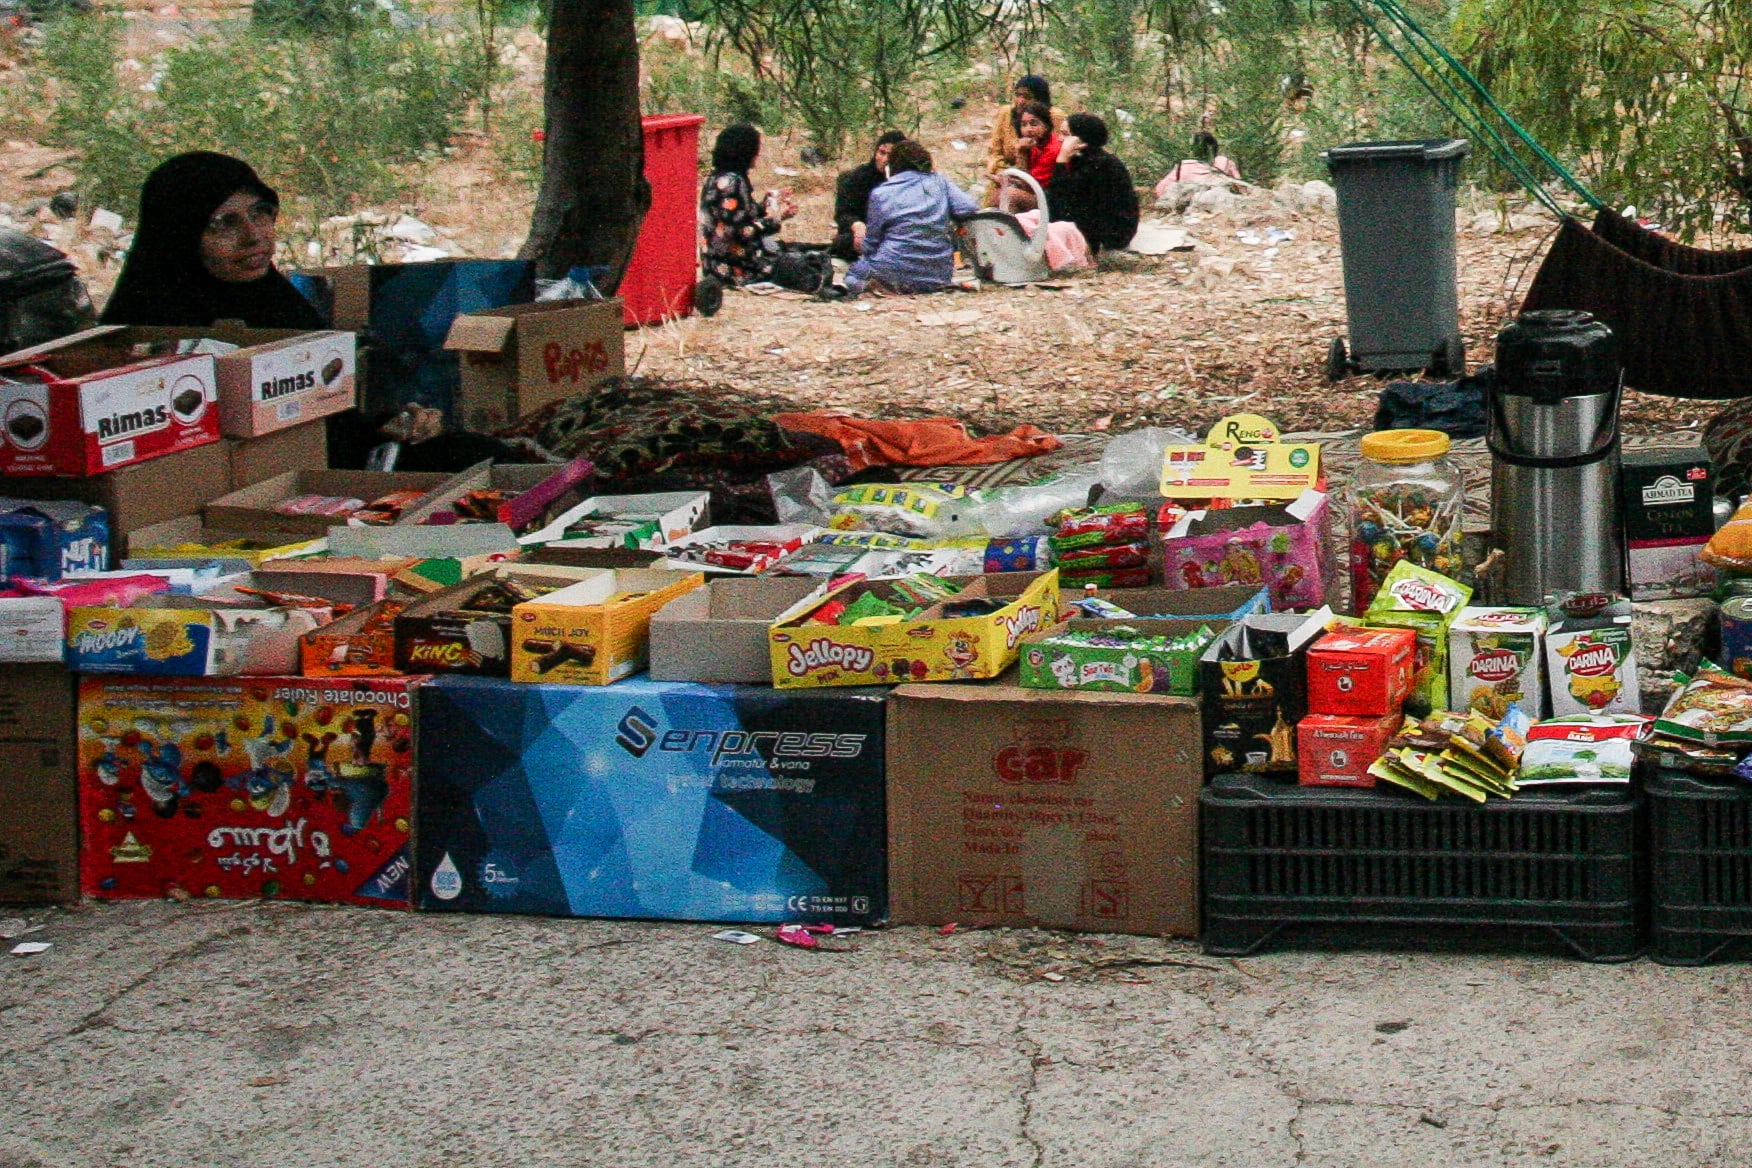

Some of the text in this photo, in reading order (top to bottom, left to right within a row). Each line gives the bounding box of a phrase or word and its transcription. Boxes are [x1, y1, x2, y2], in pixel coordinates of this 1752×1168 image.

[261, 370, 315, 400] Rimas
[98, 404, 168, 439] Rimas
[1644, 488, 1693, 499] AHMAD TEA
[1400, 582, 1446, 610] DARINA
[79, 626, 138, 653] MOODY
[788, 638, 874, 676] Jellopy
[1472, 655, 1519, 673] DARINA
[1569, 649, 1615, 671] DARINA
[274, 687, 411, 709] Chocolate Ruler
[614, 705, 867, 766] Senpress
[769, 758, 780, 770] &
[992, 745, 1091, 785] car
[207, 816, 332, 870] مسطرة
[218, 853, 278, 875] شوكولا
[375, 854, 411, 893] NEW
